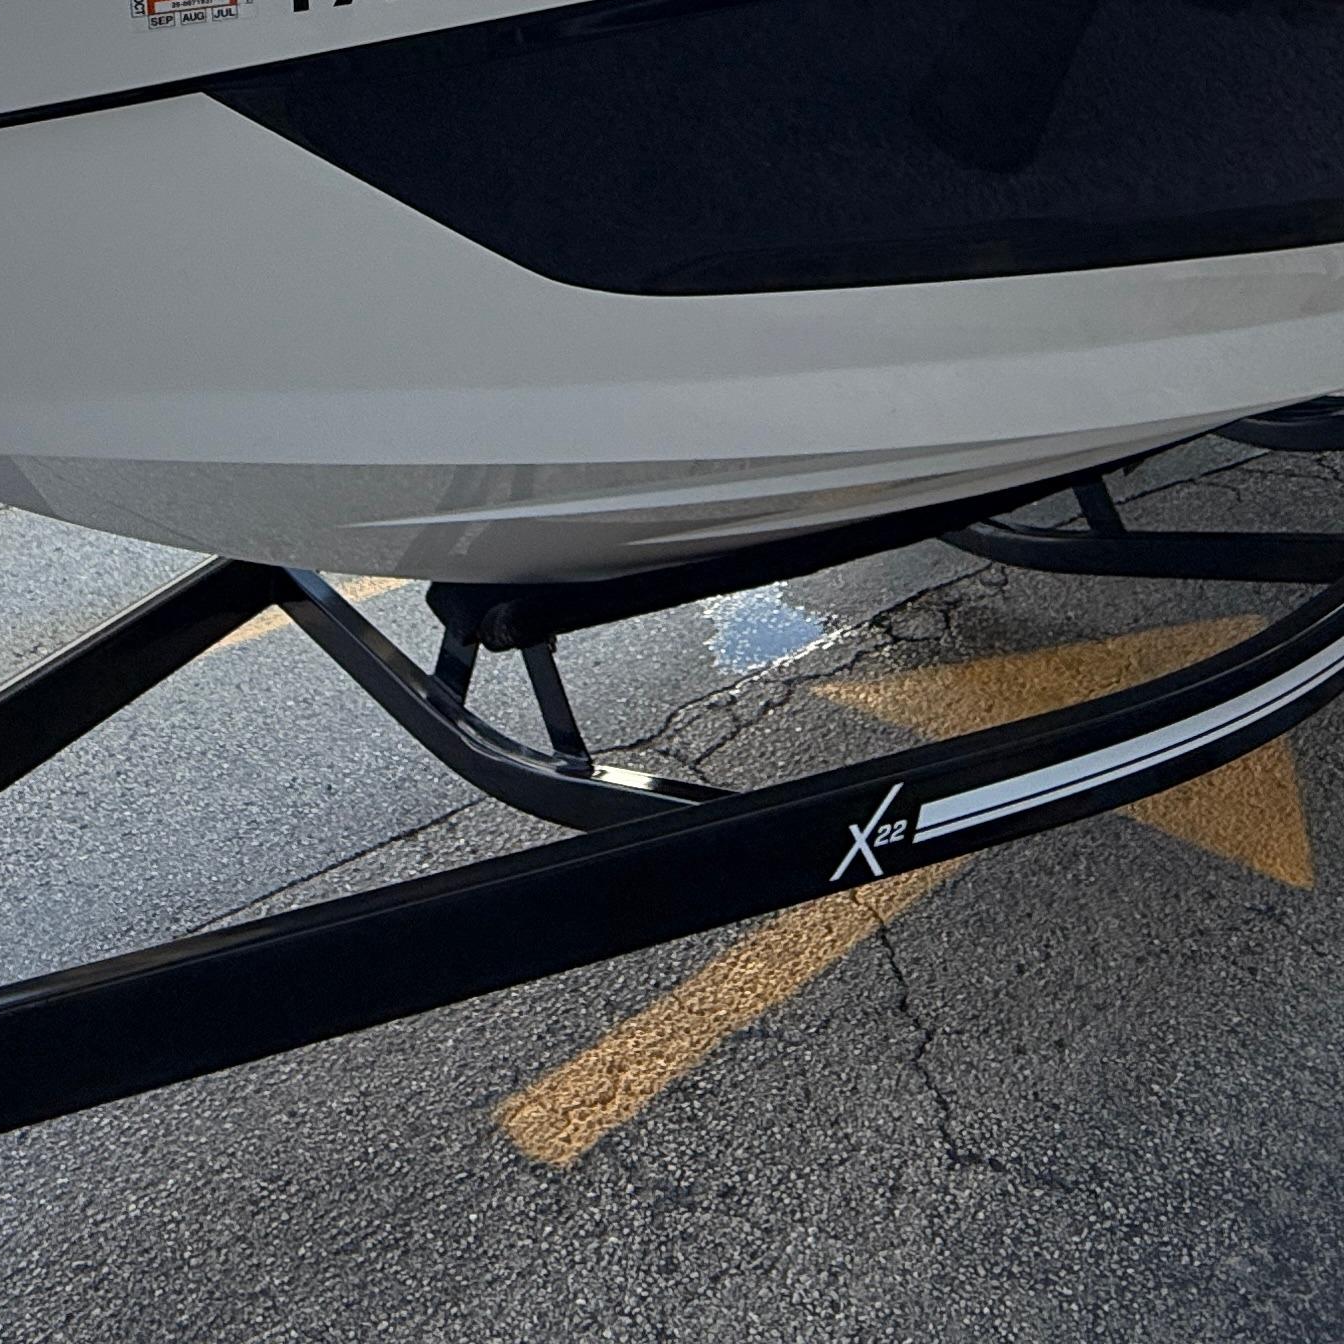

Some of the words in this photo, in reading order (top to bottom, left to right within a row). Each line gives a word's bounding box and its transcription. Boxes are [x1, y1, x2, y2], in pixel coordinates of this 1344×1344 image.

[150, 15, 174, 27] SEP
[182, 11, 205, 23] AUG
[213, 7, 236, 19] JUL
